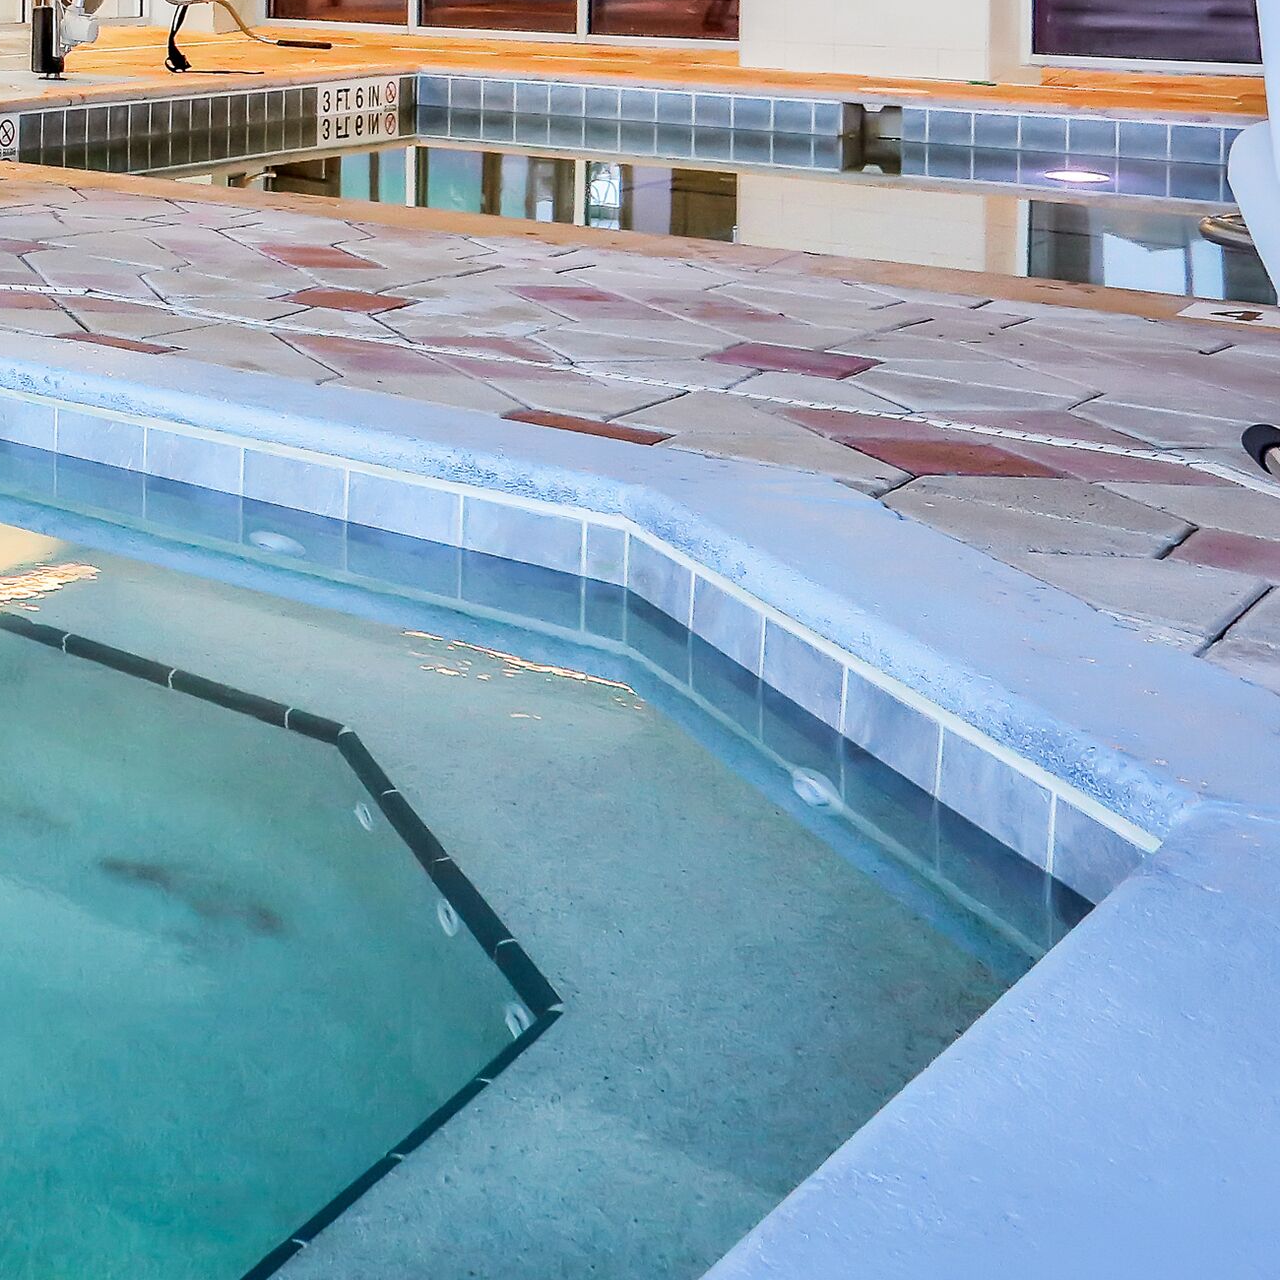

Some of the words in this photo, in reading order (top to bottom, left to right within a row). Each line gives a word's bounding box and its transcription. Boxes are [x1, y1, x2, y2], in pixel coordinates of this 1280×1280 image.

[323, 91, 331, 112] 3
[336, 88, 351, 111] FT.
[355, 87, 364, 108] 6
[368, 85, 382, 108] IN.
